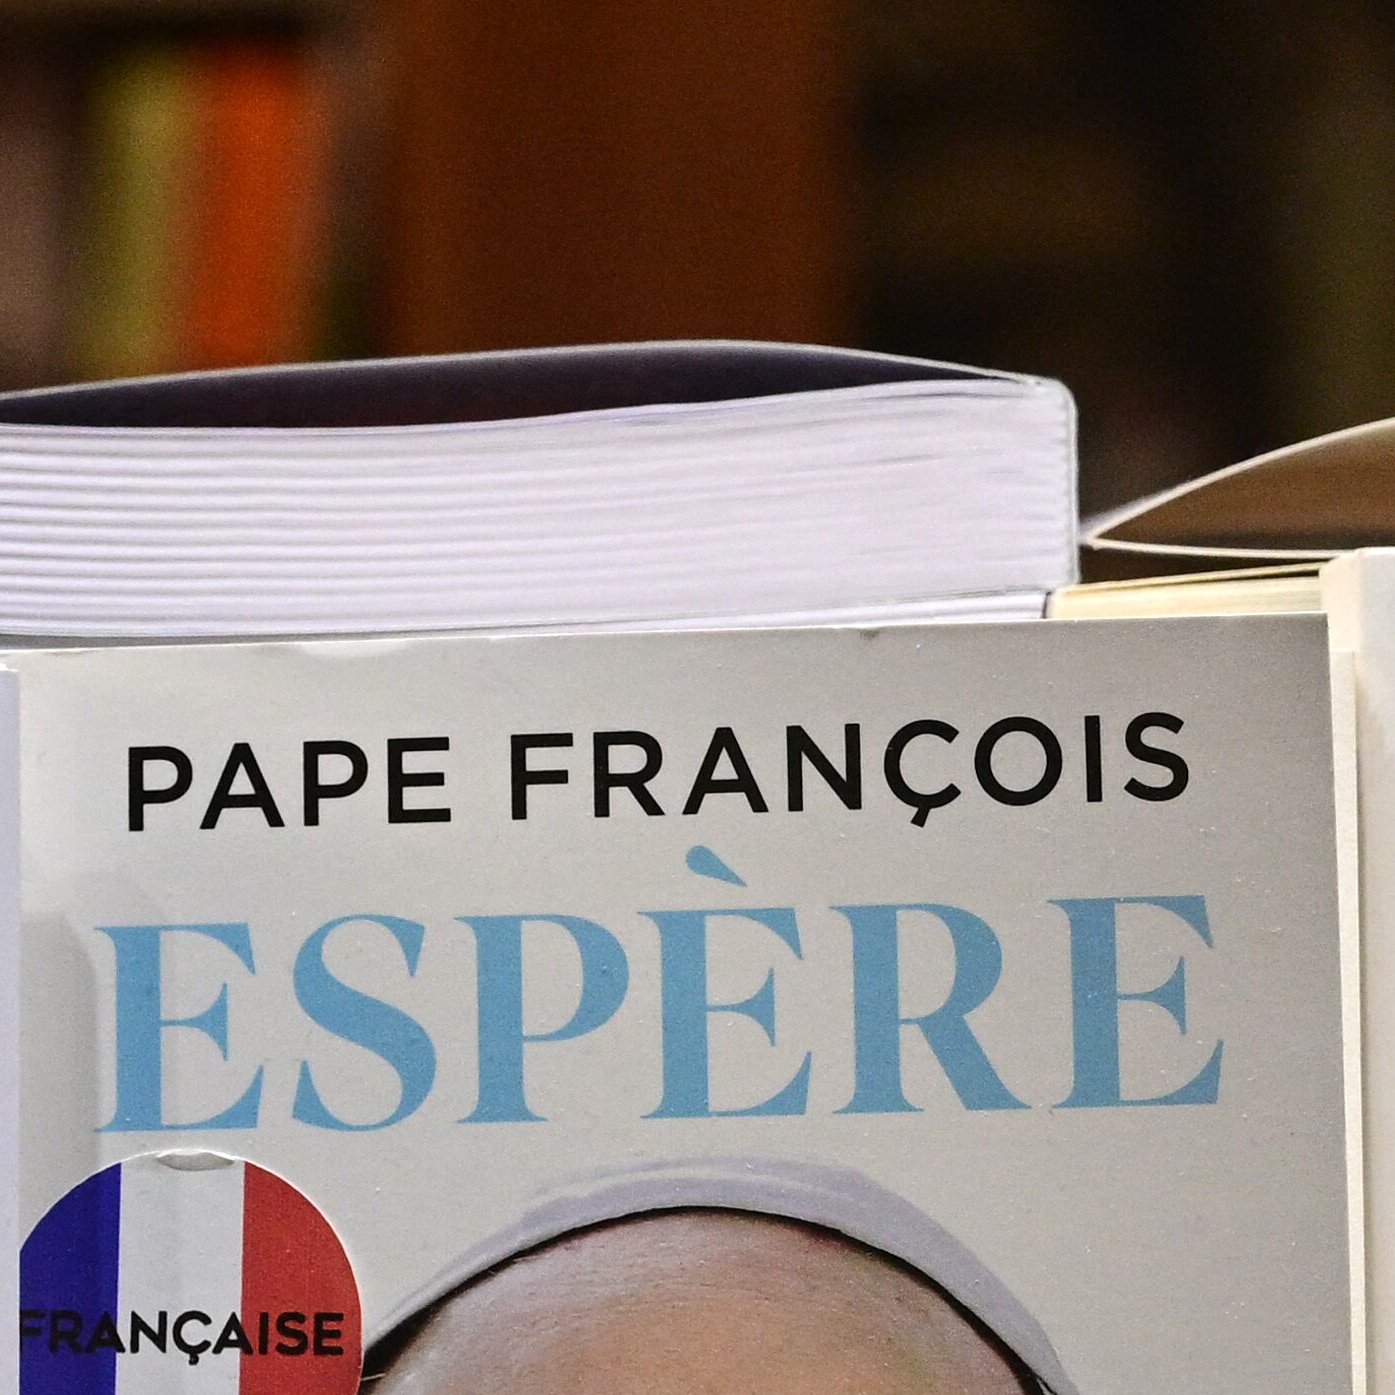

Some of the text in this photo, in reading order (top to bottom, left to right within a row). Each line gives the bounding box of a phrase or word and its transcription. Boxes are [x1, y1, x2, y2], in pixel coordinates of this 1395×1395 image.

[129, 712, 1188, 831] PAPE FRANÇOIS
[94, 846, 1222, 1134] ESPÈRE
[20, 1310, 345, 1366] FRANÇAISE
